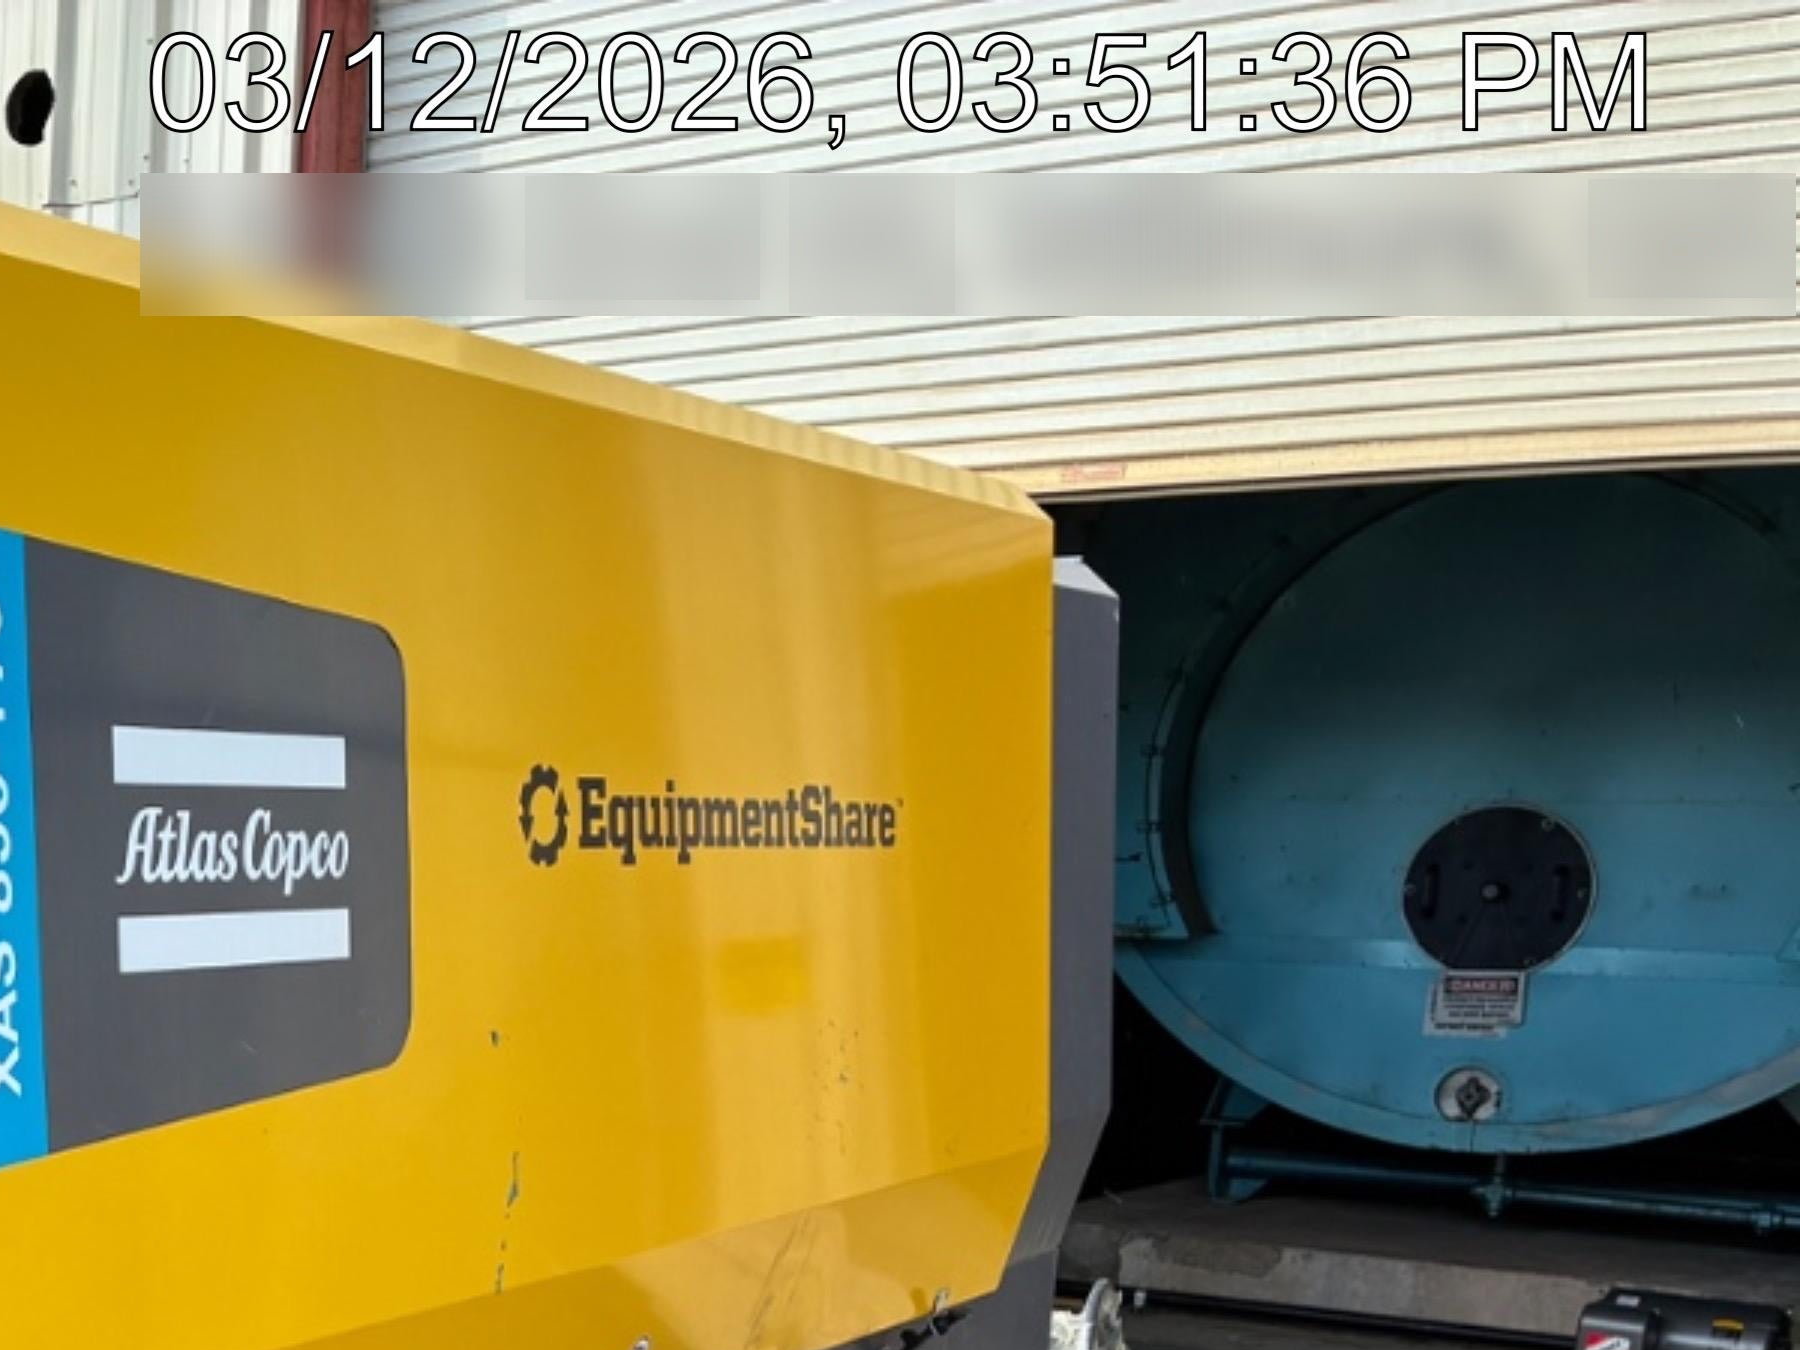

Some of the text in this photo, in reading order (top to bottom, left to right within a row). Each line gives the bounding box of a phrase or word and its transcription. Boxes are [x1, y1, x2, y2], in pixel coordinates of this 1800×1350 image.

[115, 806, 350, 897] Atlas Copco
[577, 776, 897, 865] EquipmentShare
